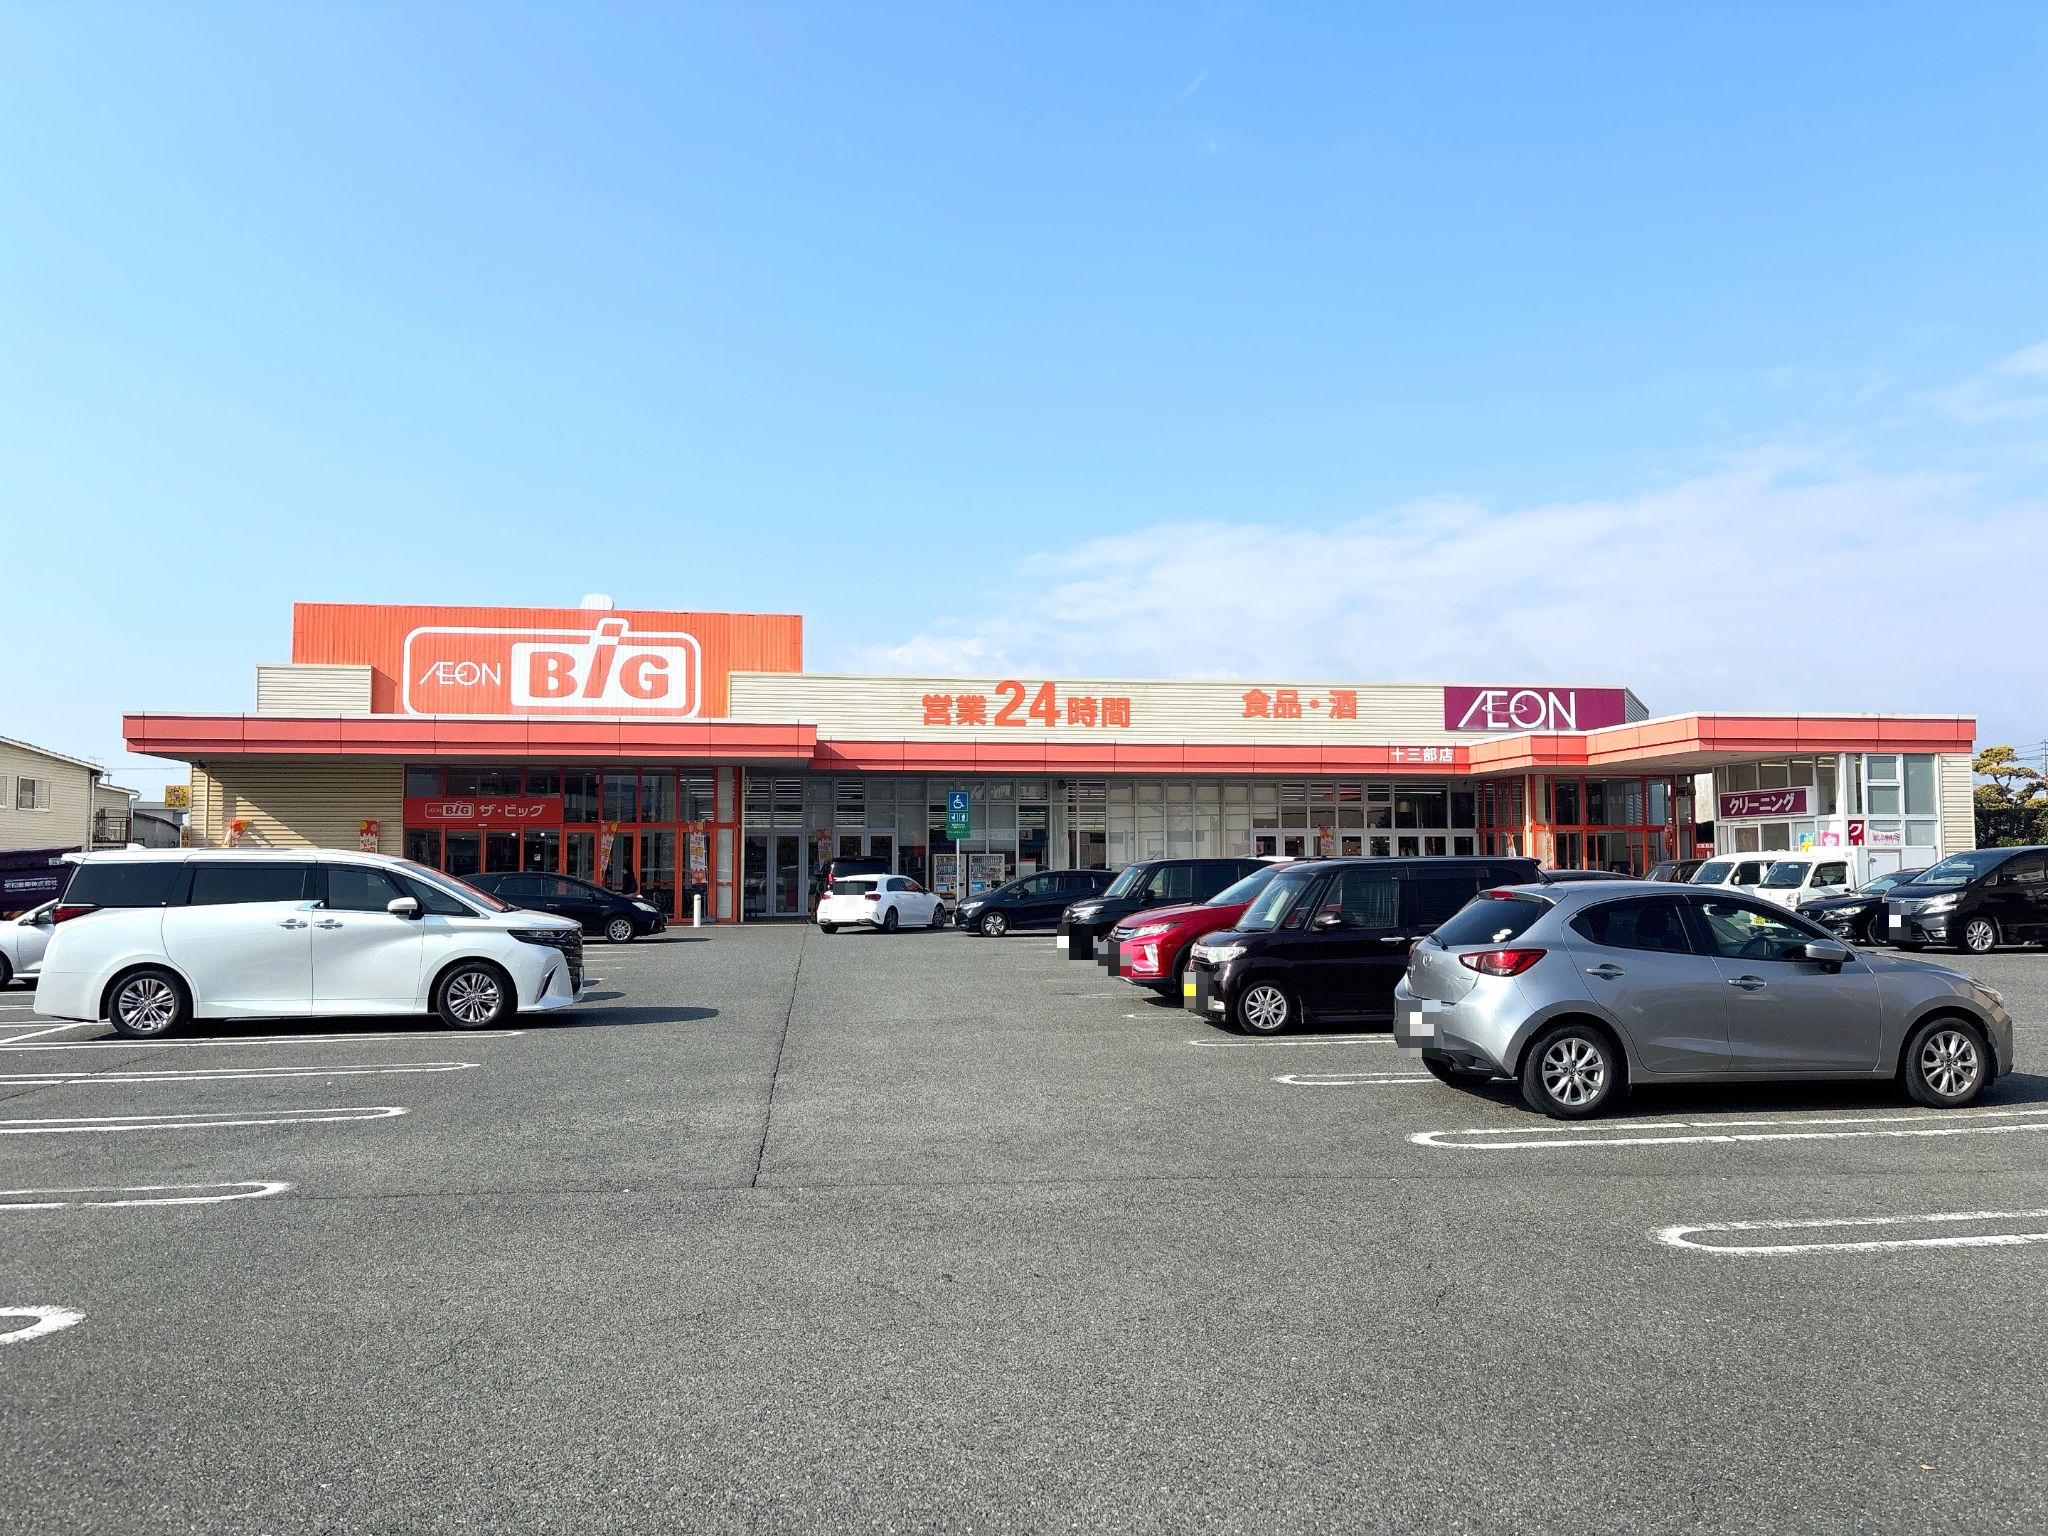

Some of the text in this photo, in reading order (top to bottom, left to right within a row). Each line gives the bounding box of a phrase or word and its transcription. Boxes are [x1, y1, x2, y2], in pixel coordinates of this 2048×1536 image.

[922, 680, 1131, 728] 営業24時間
[1241, 688, 1358, 720] 食品・酒
[1457, 690, 1578, 730] AEON
[1390, 747, 1453, 763] 十三部店
[479, 804, 546, 817] ザ・ビッグ
[1729, 792, 1795, 815] クリーニング
